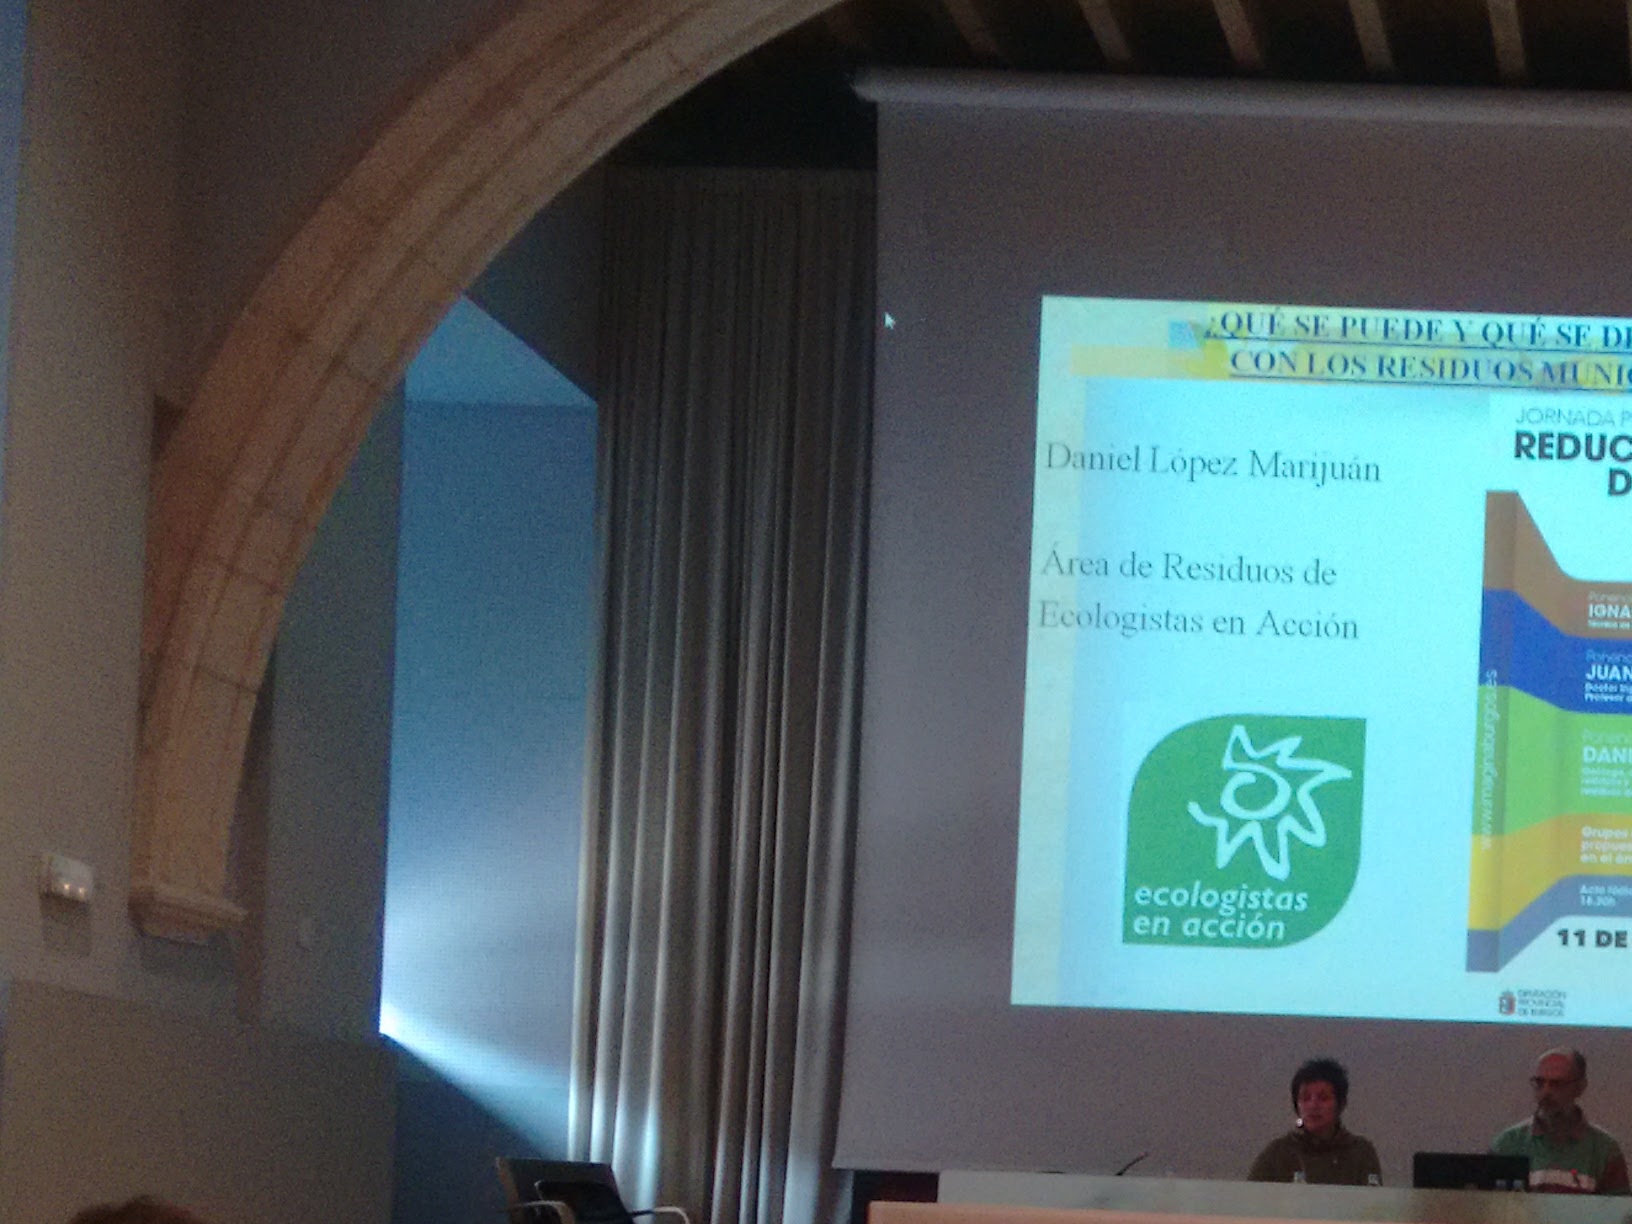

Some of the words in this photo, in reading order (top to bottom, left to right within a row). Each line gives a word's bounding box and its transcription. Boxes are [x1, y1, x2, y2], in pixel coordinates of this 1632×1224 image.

[1296, 314, 1329, 337] SE
[1341, 316, 1443, 341] PUEDE
[1453, 319, 1473, 342] Y
[1482, 317, 1544, 347] QUÉ
[1557, 323, 1591, 347] SE
[1231, 350, 1297, 373] CON
[1308, 352, 1367, 376] LOS
[1378, 354, 1533, 382] RESIDUOS
[1516, 408, 1614, 426] JORNADA
[1047, 443, 1141, 473] Daniel
[1150, 446, 1238, 482] López
[1250, 449, 1381, 487] Marijuán
[1041, 541, 1108, 577] Área
[1120, 551, 1152, 579] de
[1163, 552, 1293, 583] Residuos
[1303, 558, 1336, 585] de
[1040, 601, 1201, 638] Ecologistas
[1213, 612, 1245, 635] en
[1257, 609, 1359, 640] Acción
[1134, 880, 1308, 917] ecologistas
[1133, 914, 1170, 936] en
[1182, 912, 1285, 940] acción
[1557, 929, 1586, 947] 11
[1595, 930, 1628, 948] DE
